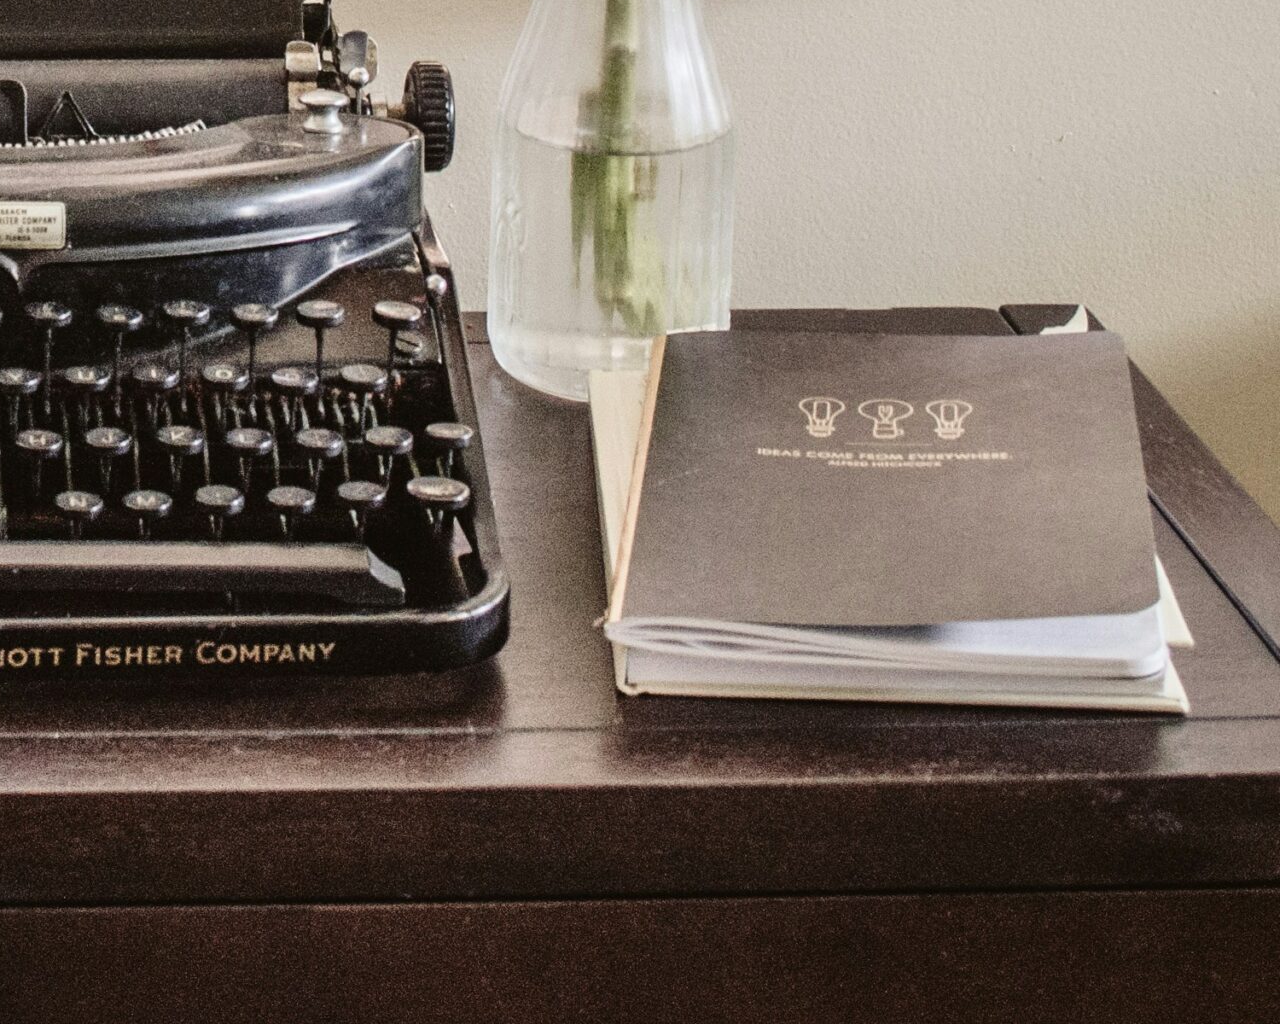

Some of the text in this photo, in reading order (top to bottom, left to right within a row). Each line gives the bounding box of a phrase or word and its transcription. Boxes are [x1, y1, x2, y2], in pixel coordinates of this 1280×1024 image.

[22, 217, 57, 225] COMPANY
[756, 447, 802, 458] IDEAS
[806, 449, 853, 460] COME
[858, 451, 904, 461] FROM
[75, 643, 183, 667] FISHER
[195, 640, 337, 665] COMPANY
